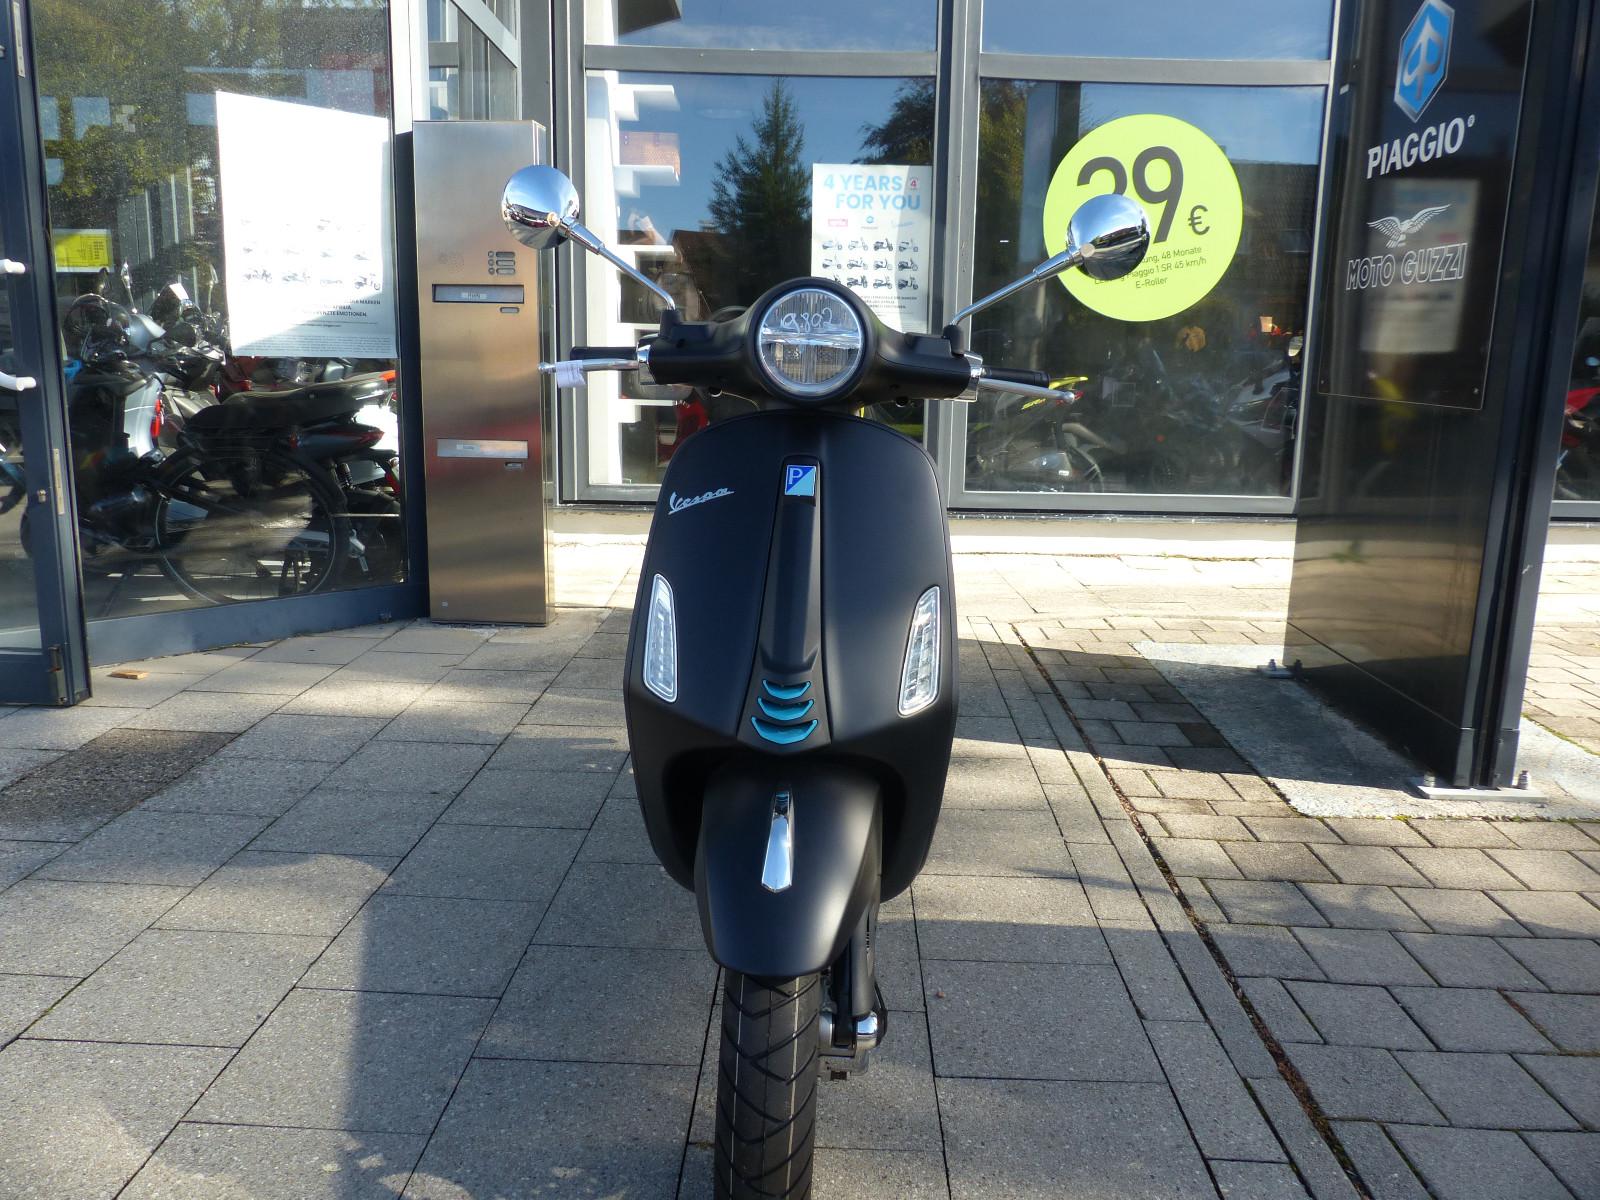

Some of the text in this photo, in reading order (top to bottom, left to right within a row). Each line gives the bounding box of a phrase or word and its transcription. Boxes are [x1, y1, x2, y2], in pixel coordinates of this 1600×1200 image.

[824, 175, 903, 191] 4 YEARS
[836, 193, 921, 210] FOR YOU
[1188, 205, 1210, 235] €
[1161, 250, 1172, 259] 48
[1173, 247, 1202, 257] Monate
[1161, 263, 1173, 272] SR
[1174, 260, 1184, 269] 45
[1185, 256, 1207, 267] km/h
[1346, 243, 1468, 291] MOTO GUZZI
[1136, 277, 1168, 289] E-Roller
[788, 467, 803, 485] P
[668, 487, 735, 515] Vespa
